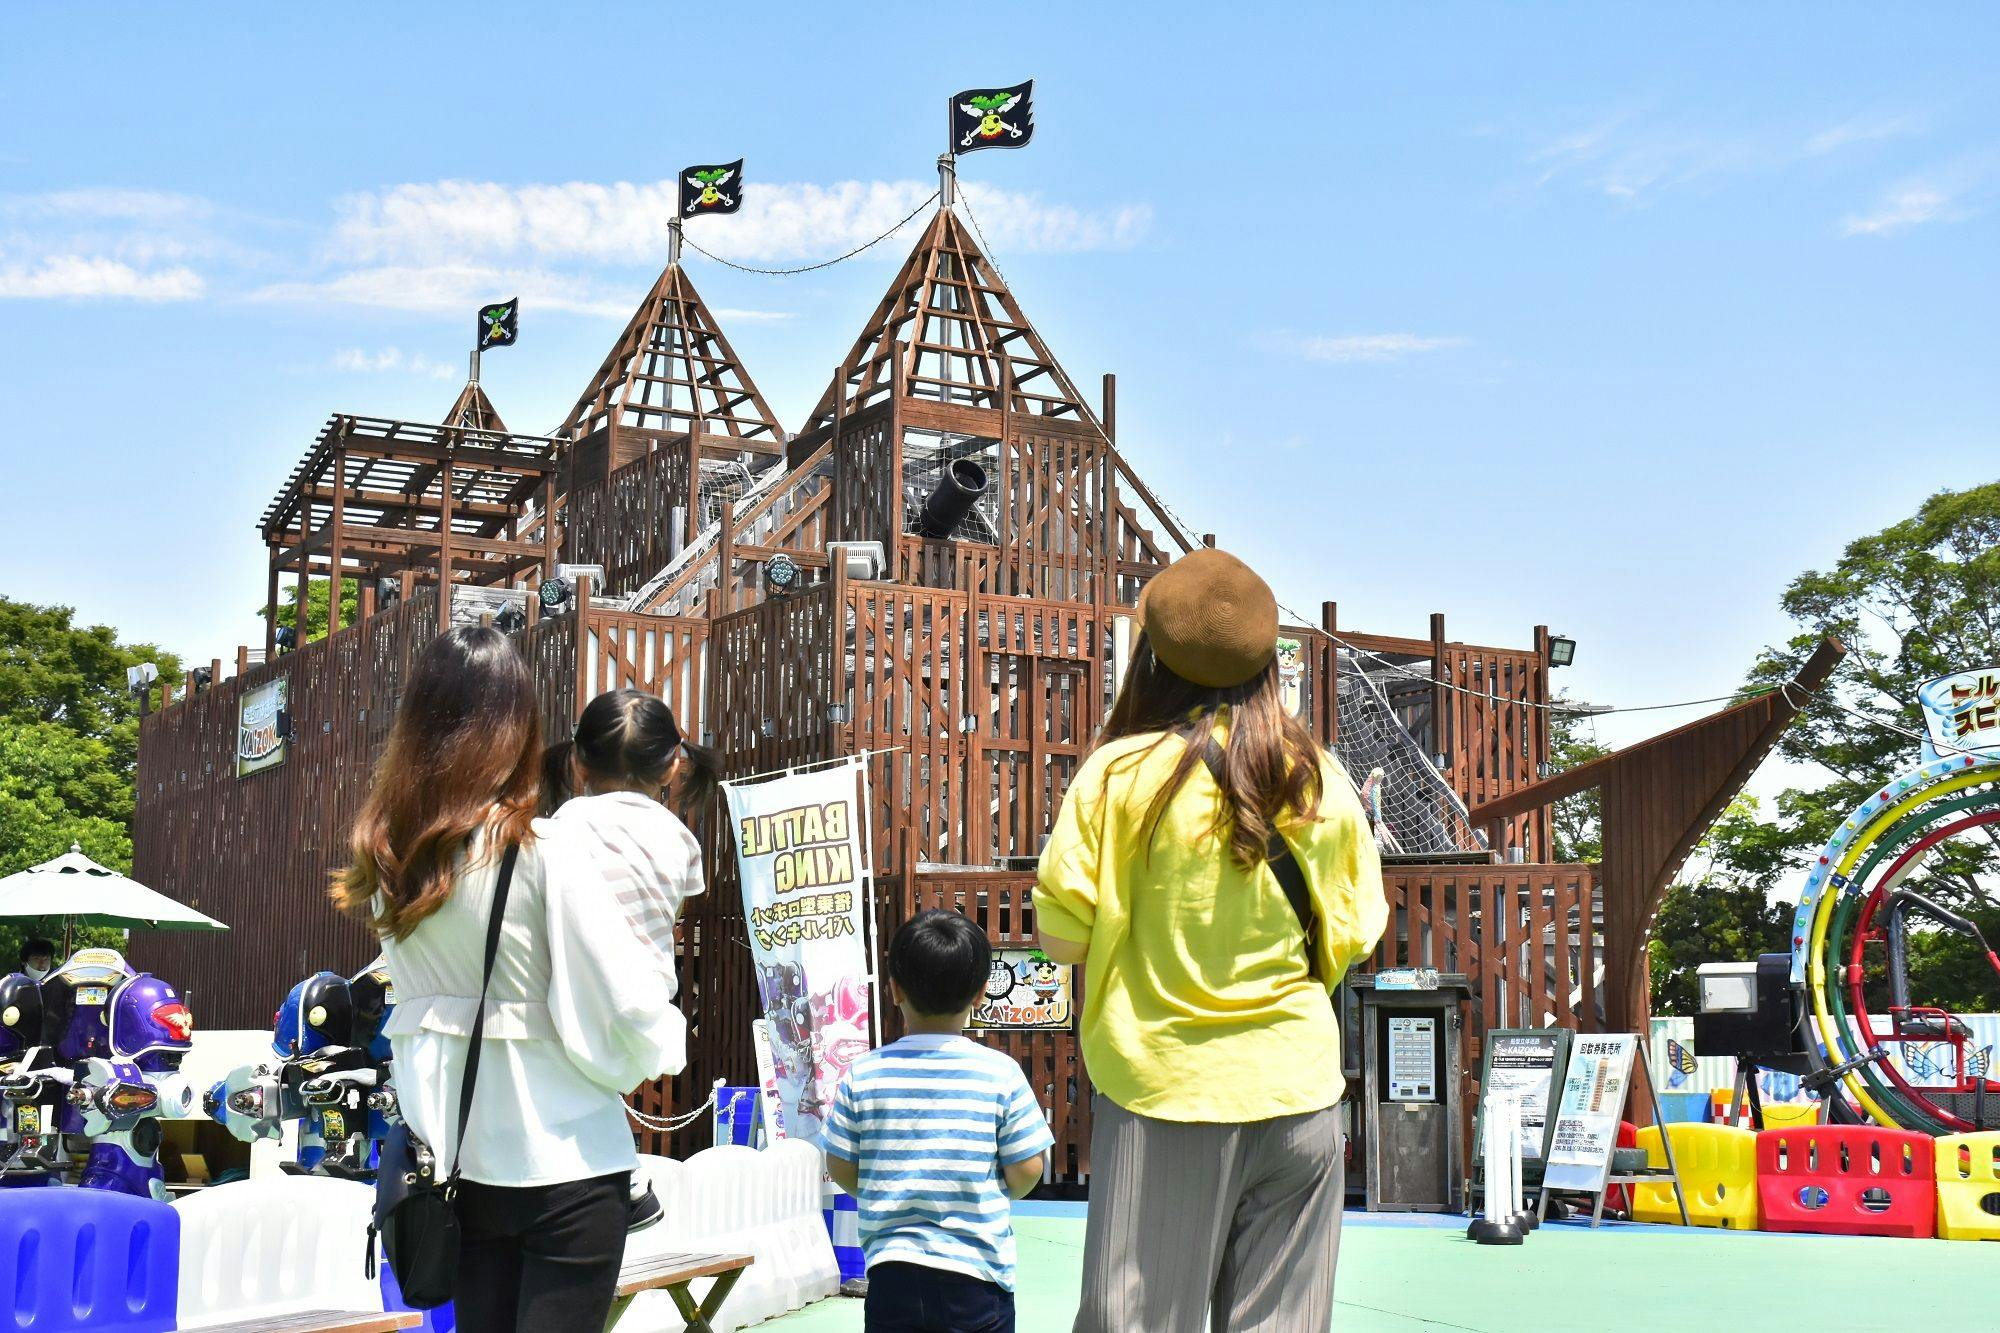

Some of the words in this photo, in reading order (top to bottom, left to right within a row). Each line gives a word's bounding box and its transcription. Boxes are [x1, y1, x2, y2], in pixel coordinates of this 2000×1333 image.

[1579, 1043, 1622, 1055] 回数券販売所
